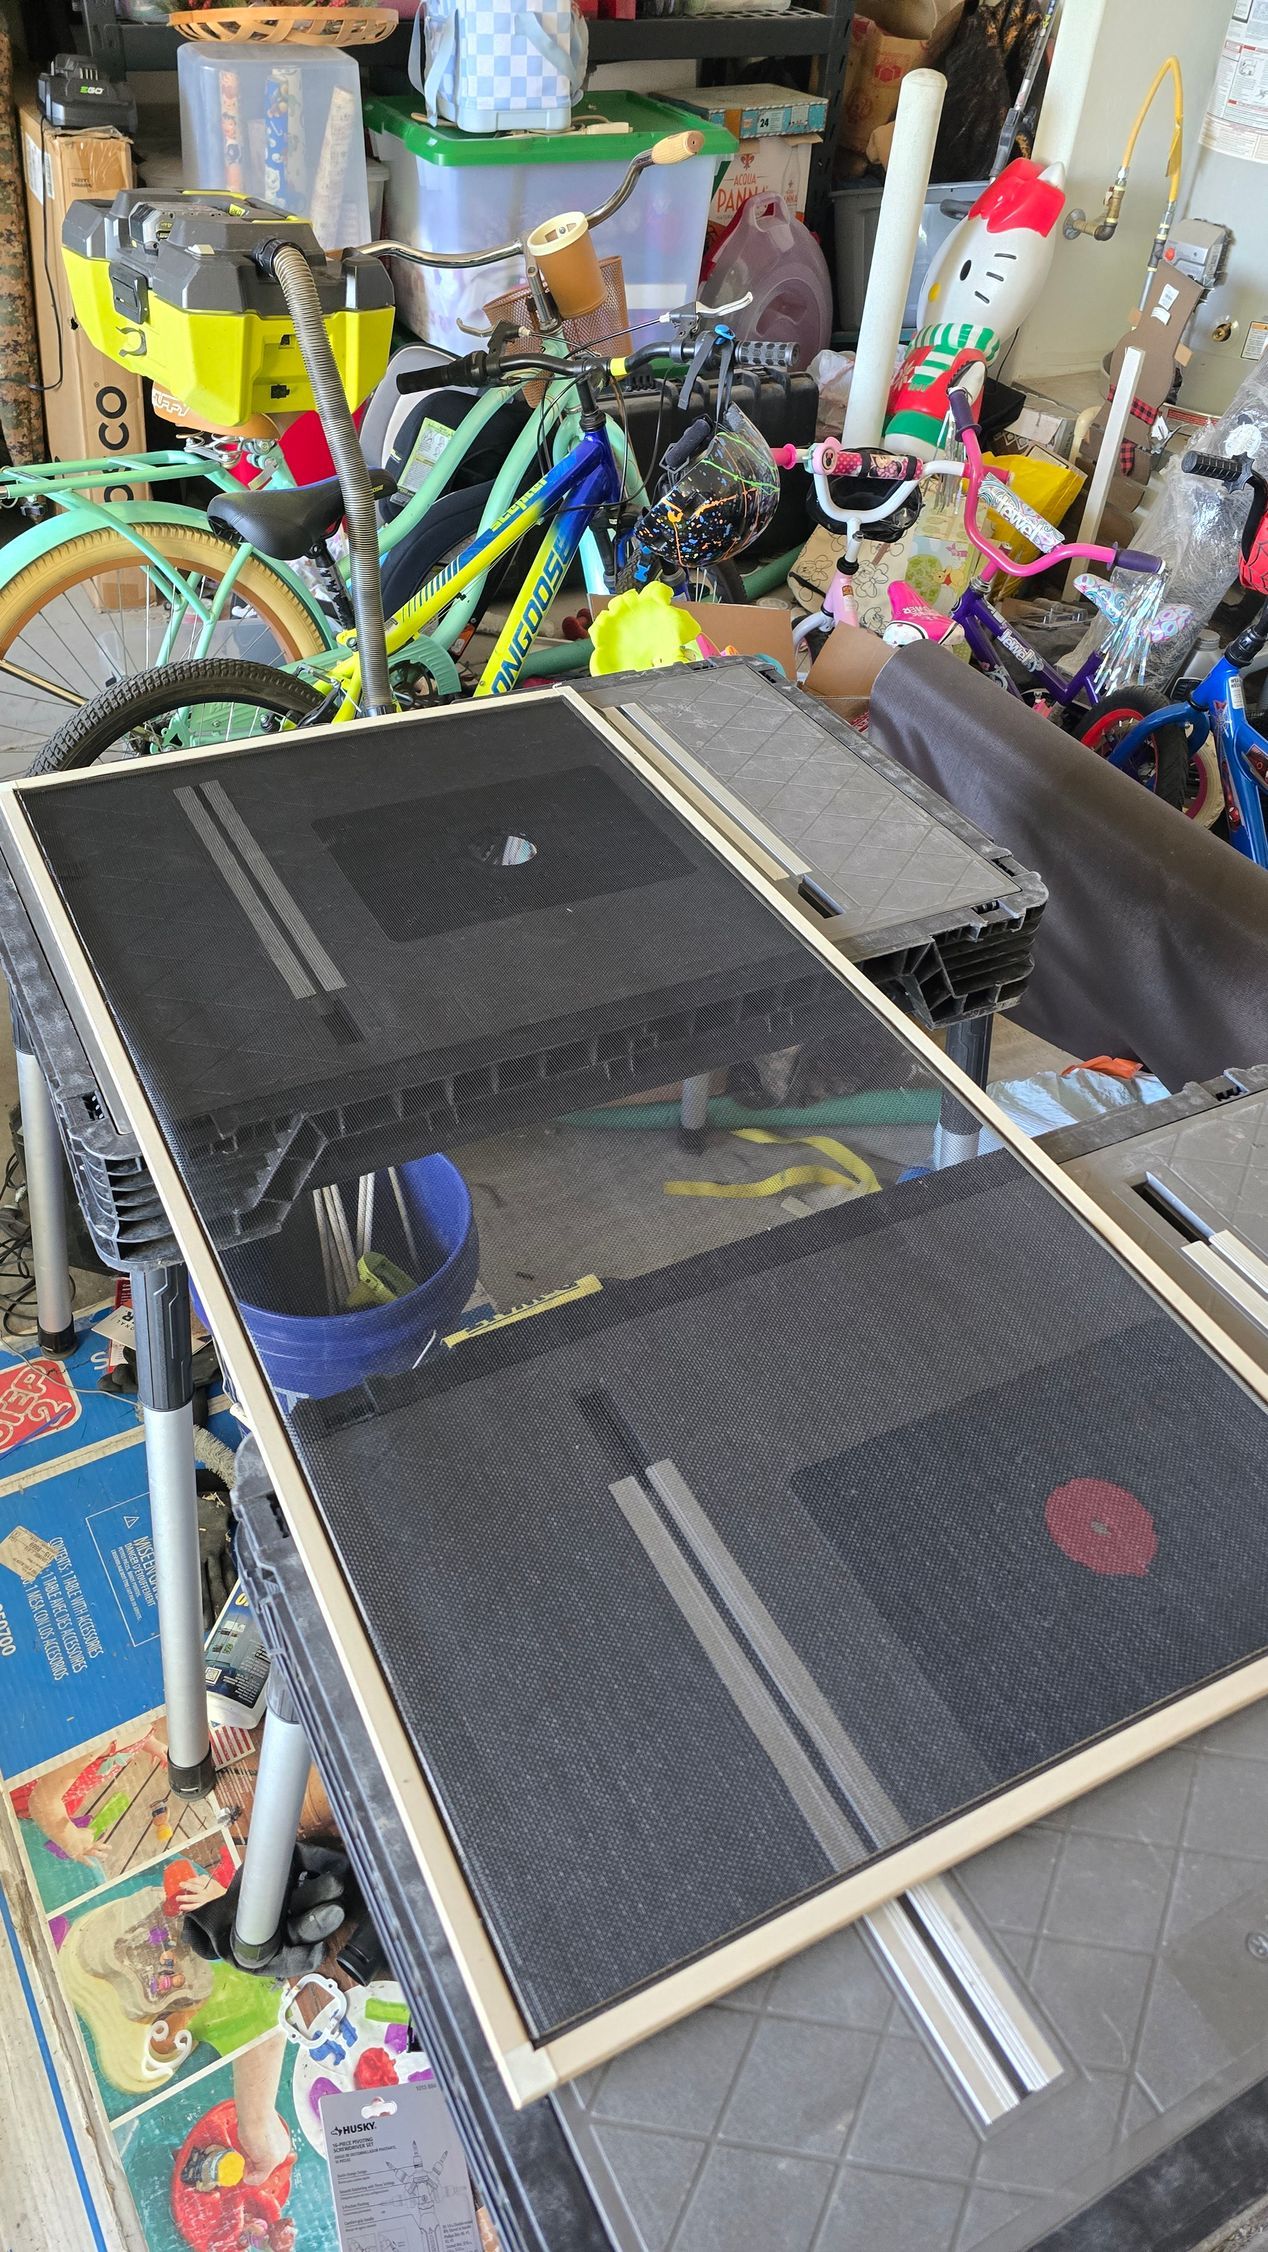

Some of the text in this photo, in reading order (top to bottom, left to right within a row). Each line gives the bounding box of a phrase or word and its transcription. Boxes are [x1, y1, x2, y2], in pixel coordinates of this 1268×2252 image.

[80, 86, 103, 94] EGO
[760, 118, 769, 127] 24
[733, 174, 756, 185] ACQUA
[717, 186, 766, 213] PAN
[997, 629, 1037, 667] Jewel
[42, 1577, 61, 1600] TABLE
[63, 1575, 82, 1598] TABLE
[26, 1589, 45, 1612] MESA
[50, 1597, 69, 1617] AVEC
[70, 1596, 89, 1616] WITH
[33, 1609, 50, 1627] CON
[55, 1613, 73, 1630] DES
[38, 1625, 54, 1640] LOS
[77, 1613, 104, 1659] ACCESSORIES
[42, 1637, 69, 1681] ACCESORIOS
[343, 2122, 375, 2134] HUSKY
